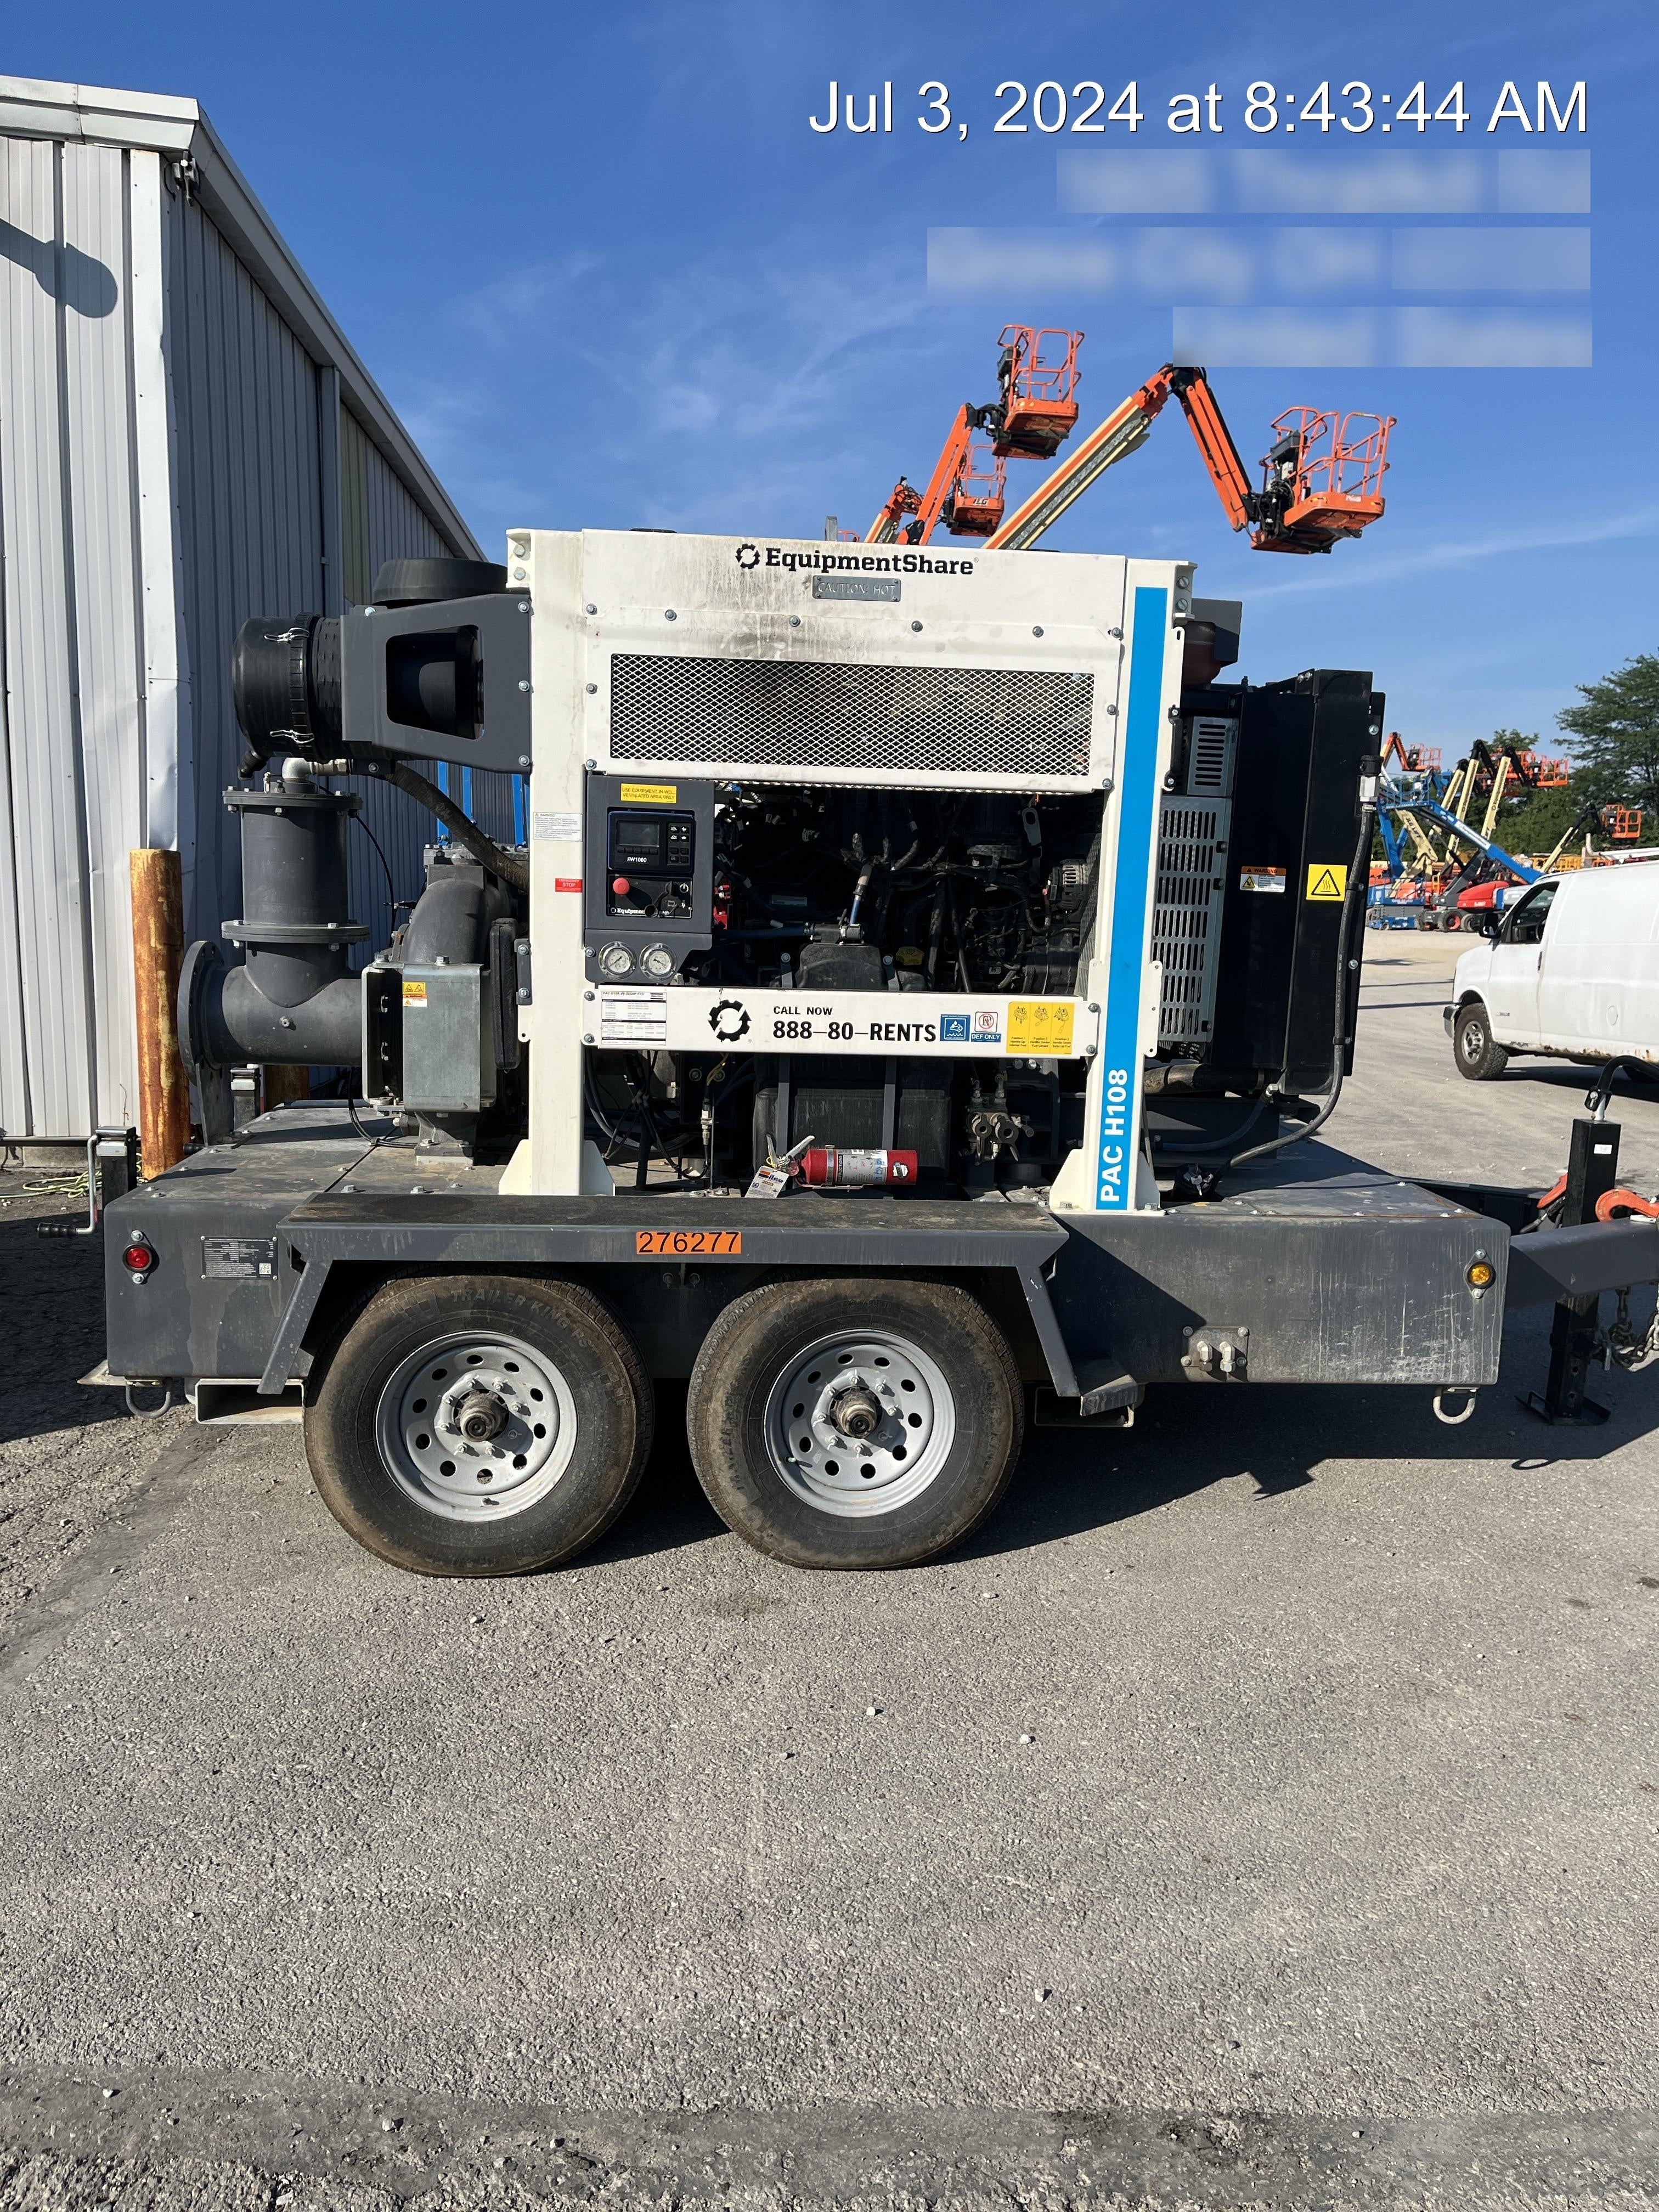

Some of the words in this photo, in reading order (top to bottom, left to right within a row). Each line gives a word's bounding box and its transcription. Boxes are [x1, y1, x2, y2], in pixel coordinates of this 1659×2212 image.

[766, 547, 974, 575] EquipmentShare
[817, 582, 869, 594] CAUTION:
[873, 584, 896, 595] HOT
[774, 1006, 800, 1015] CALL
[806, 1007, 833, 1015] NOW
[1104, 1069, 1128, 1136] H108
[1100, 1145, 1123, 1201] PAC
[639, 1231, 740, 1253] 276277
[451, 1288, 527, 1306] TRAILER
[529, 1301, 571, 1330] KING
